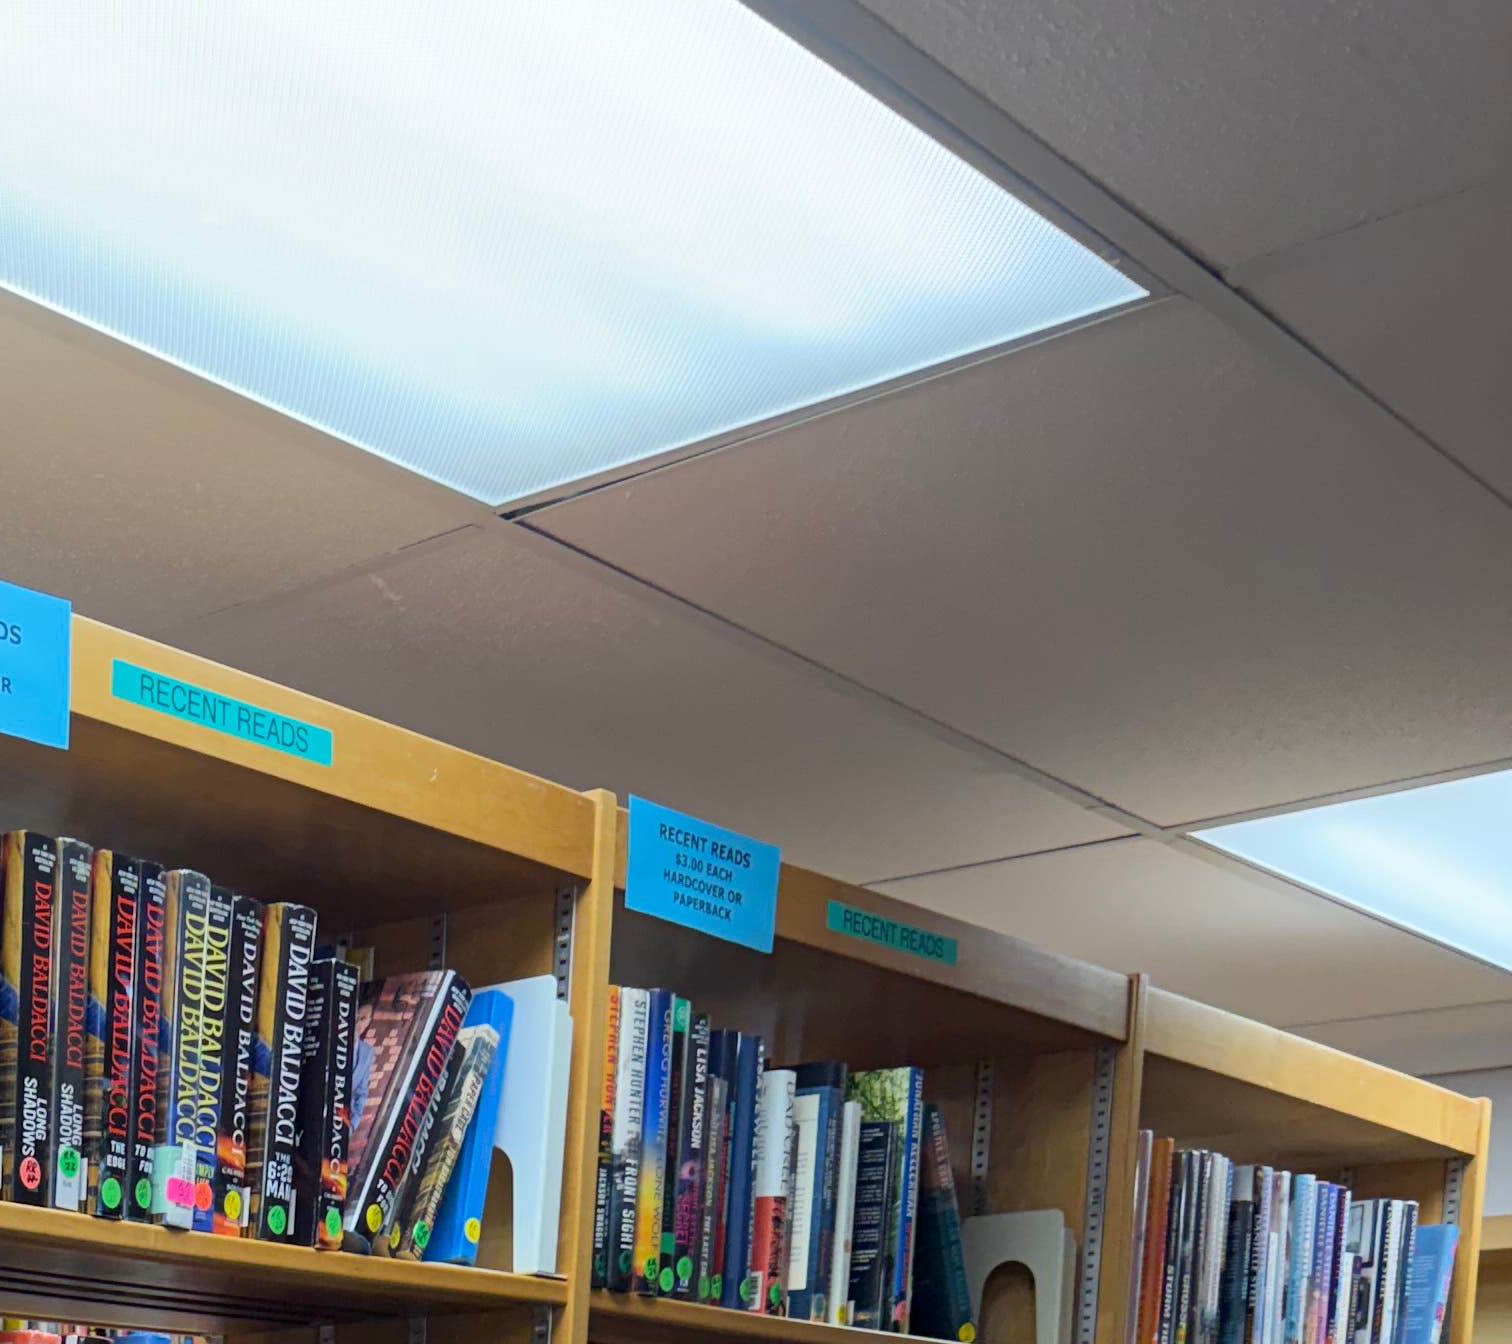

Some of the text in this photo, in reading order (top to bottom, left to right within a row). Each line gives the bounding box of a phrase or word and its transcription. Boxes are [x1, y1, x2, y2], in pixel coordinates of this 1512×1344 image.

[139, 673, 309, 754] RECENT READS
[660, 823, 751, 869] RECENT READS
[675, 853, 733, 883] $3.00 EACH
[664, 869, 742, 905] HARDCOVER OR
[673, 891, 731, 922] PAPERBACK
[844, 909, 944, 958] RECENT READS
[30, 881, 52, 1063] DAVID BALDACCI
[275, 938, 311, 1144] DAVID BALDACCI
[22, 1076, 37, 1156] SHADOWS
[34, 1097, 44, 1141] LONG
[621, 1159, 637, 1252] FRONT SIGHT
